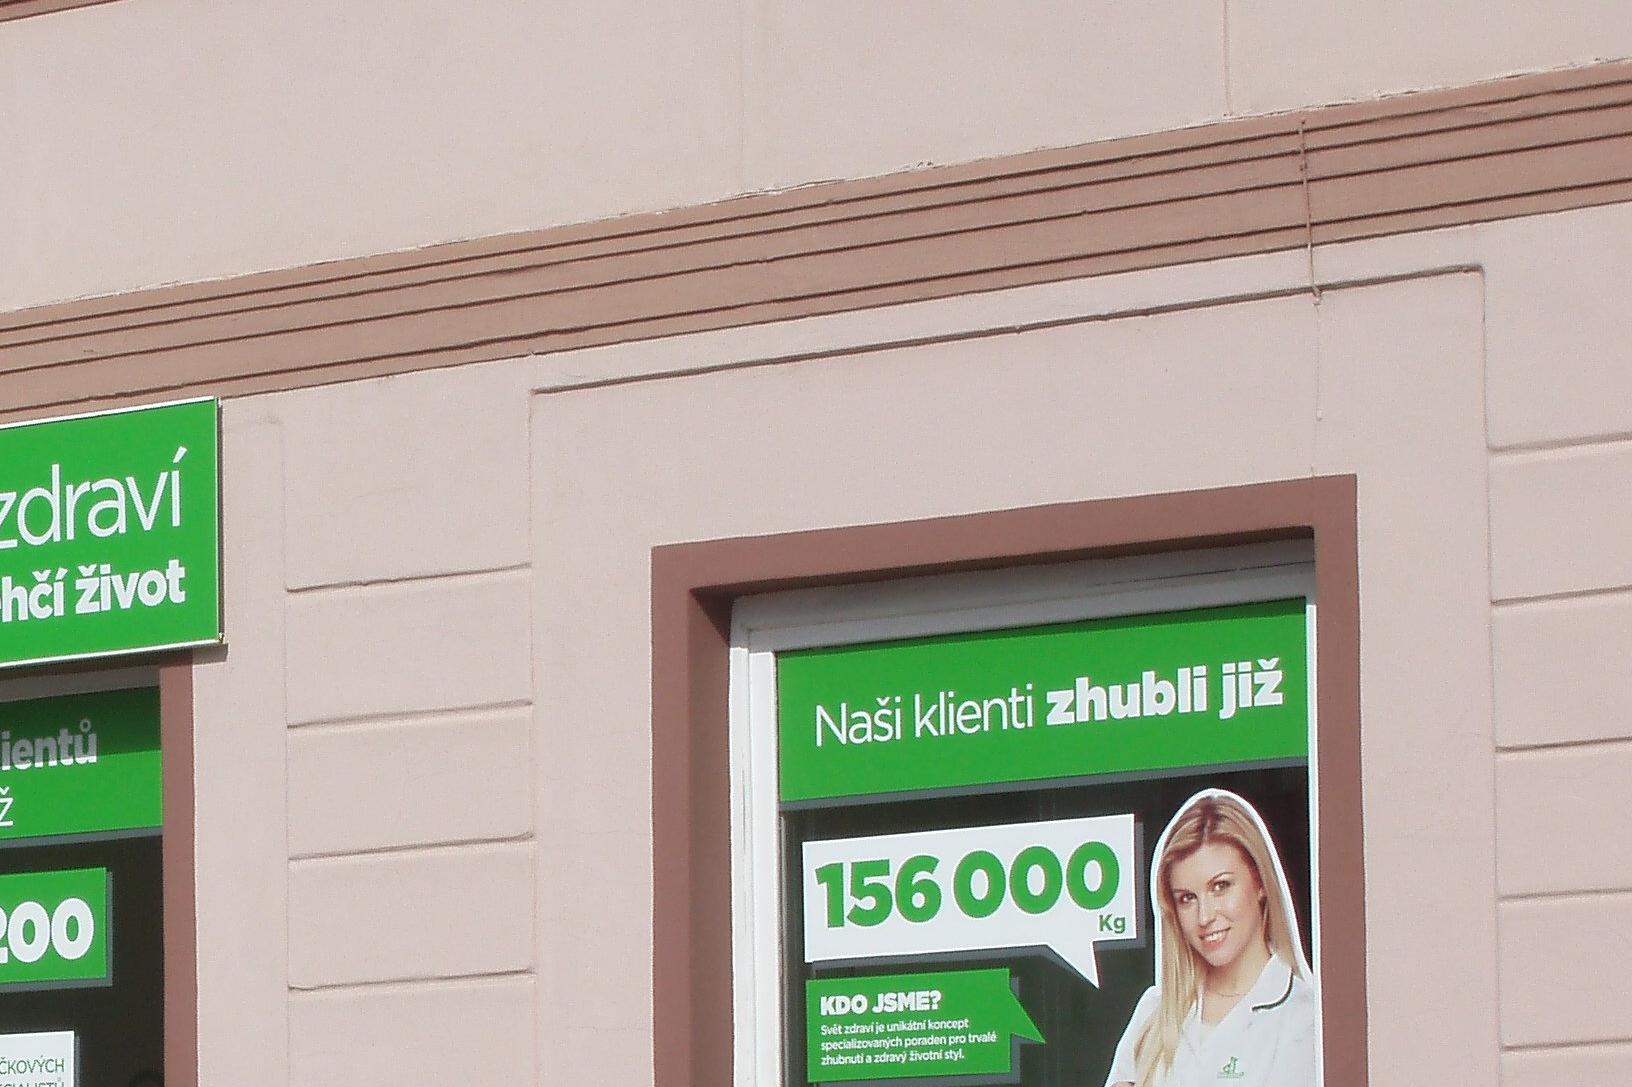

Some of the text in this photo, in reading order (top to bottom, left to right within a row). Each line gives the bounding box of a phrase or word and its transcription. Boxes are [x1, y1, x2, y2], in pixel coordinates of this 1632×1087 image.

[75, 559, 186, 615] život
[815, 657, 1283, 746] Naši klienti zhubli již
[815, 841, 1120, 929] 156 000
[1099, 915, 1126, 934] Kg
[820, 990, 941, 1015] KDO JSME?
[821, 1018, 969, 1036] Svět zdraví je unikátní koncept
[821, 1030, 996, 1052] specializovaných poraden pro trvalé
[821, 1048, 965, 1066] zhubnutí a zdravý životní styl.
